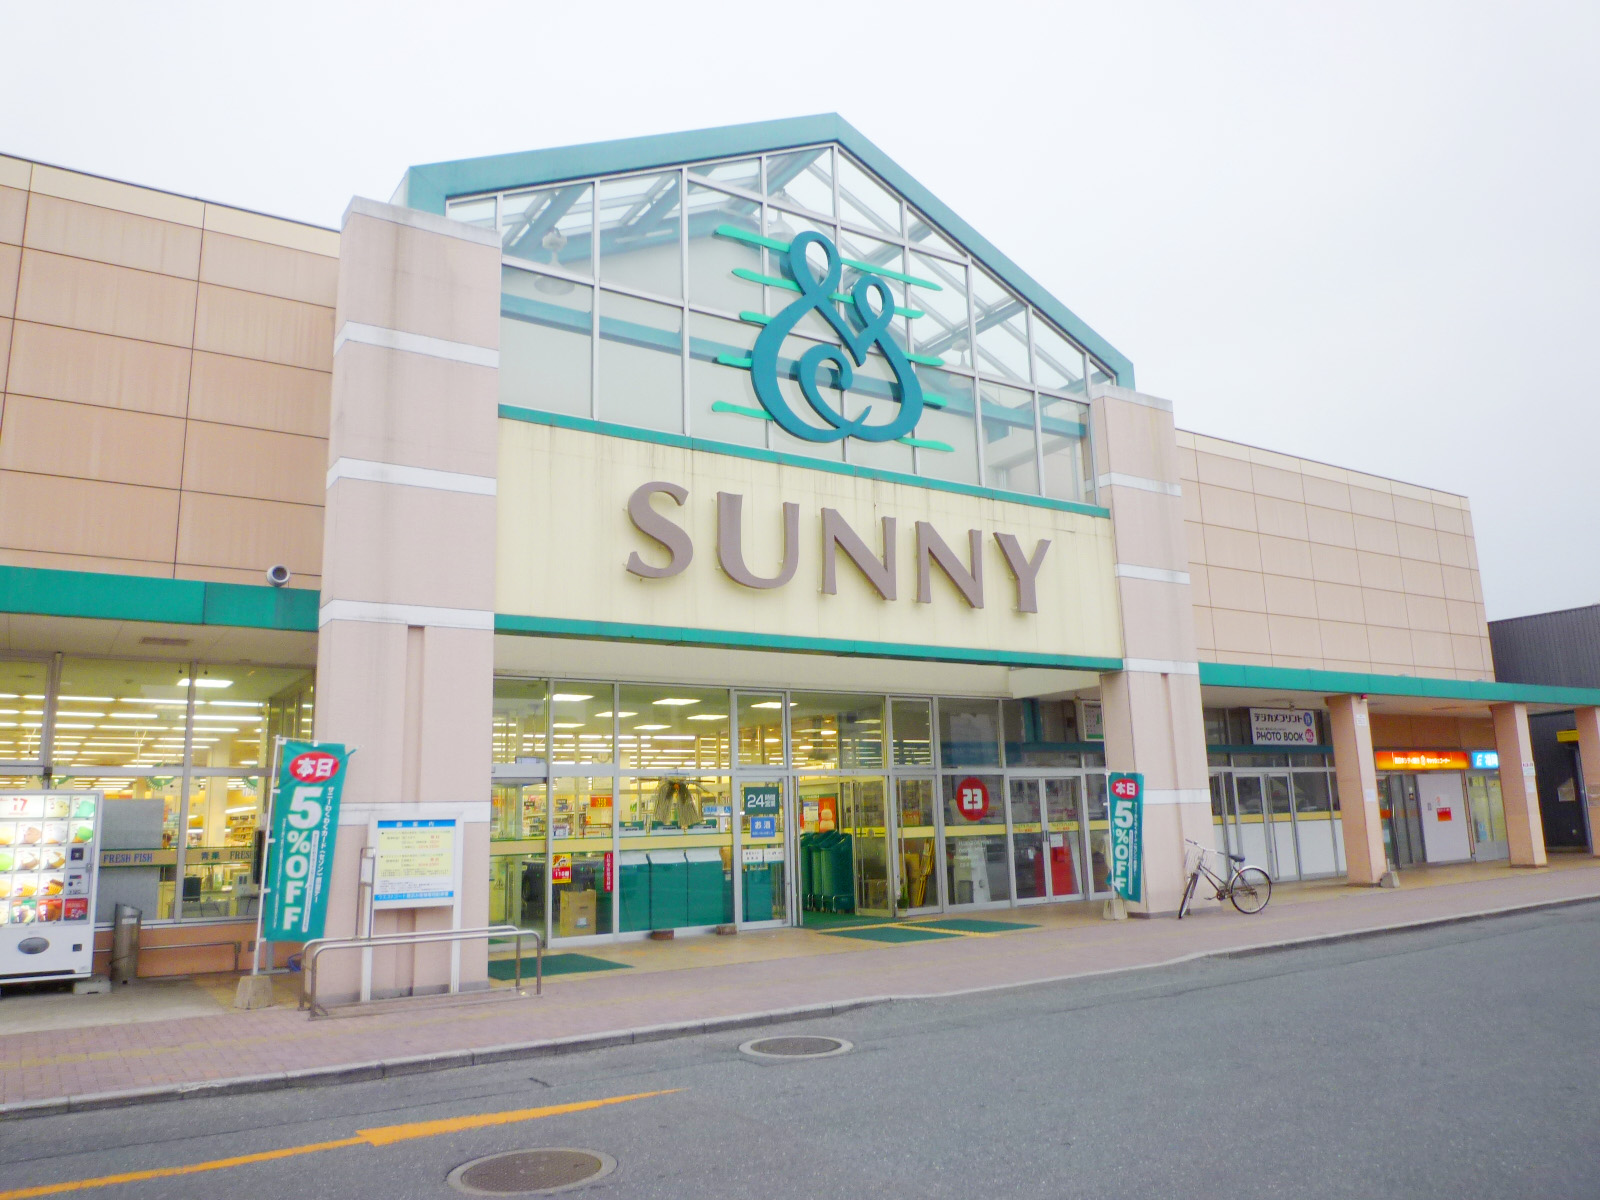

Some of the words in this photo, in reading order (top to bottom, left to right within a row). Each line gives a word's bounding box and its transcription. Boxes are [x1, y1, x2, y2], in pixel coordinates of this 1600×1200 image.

[625, 480, 1052, 614] SUNNY
[1256, 731, 1282, 741] PHOTO
[1283, 732, 1304, 742] BOOK
[296, 757, 334, 777] 本日
[1115, 782, 1136, 796] 本日
[747, 794, 764, 807] 24
[103, 853, 131, 864] FRESH
[133, 853, 153, 863] FISH
[282, 786, 324, 931] 5%OFF
